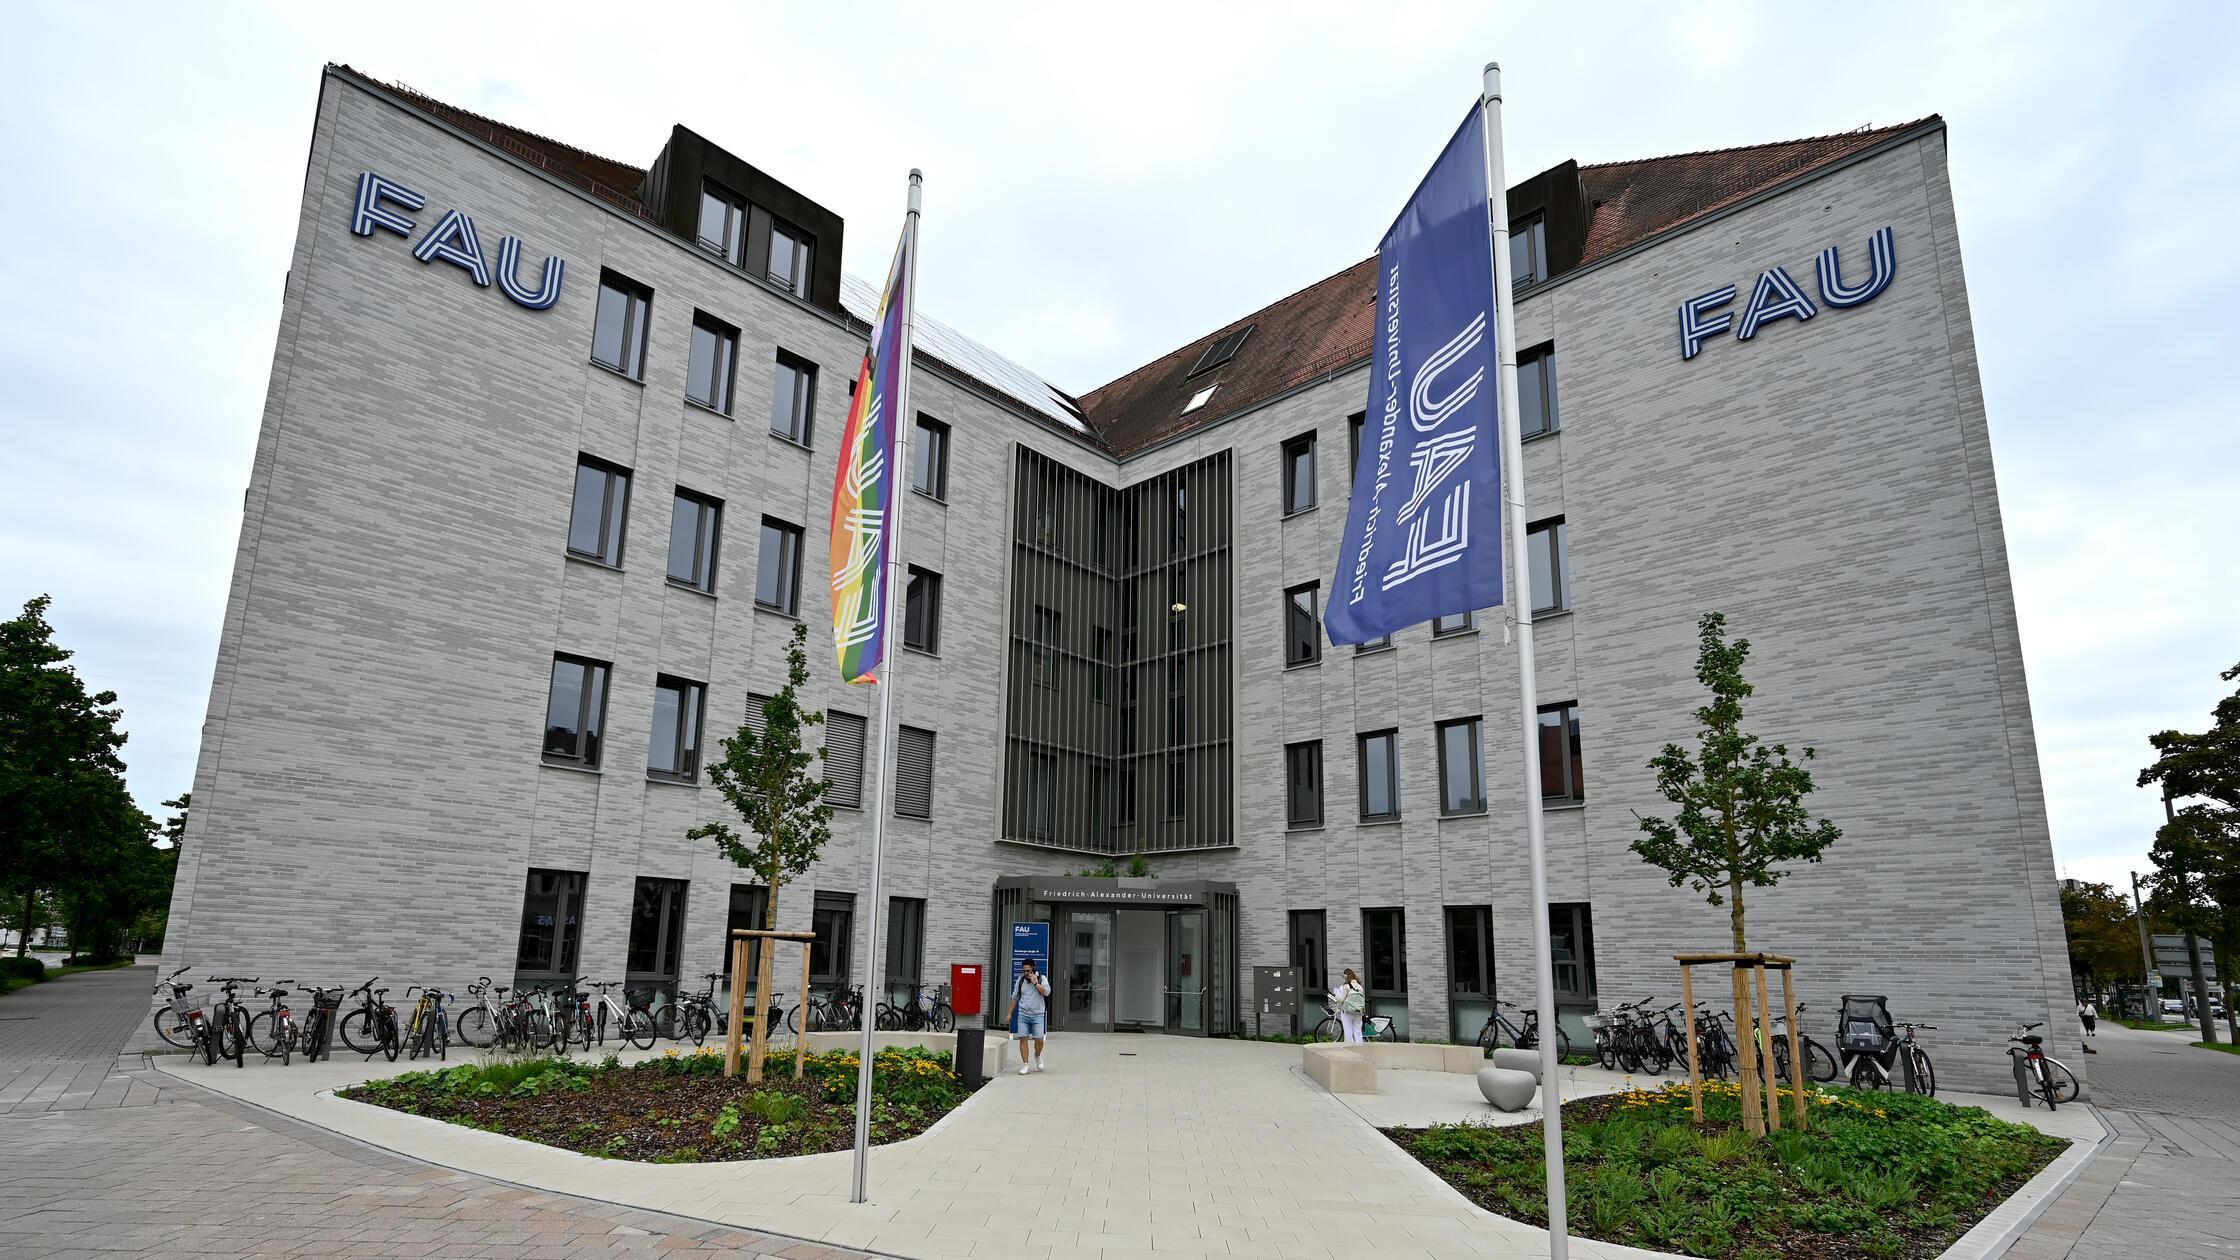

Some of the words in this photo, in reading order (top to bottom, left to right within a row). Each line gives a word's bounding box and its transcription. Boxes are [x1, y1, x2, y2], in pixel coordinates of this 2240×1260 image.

[351, 171, 565, 311] FAU
[1678, 226, 1896, 361] FAU
[1043, 890, 1193, 900] Friedrich-Alexander-Universität
